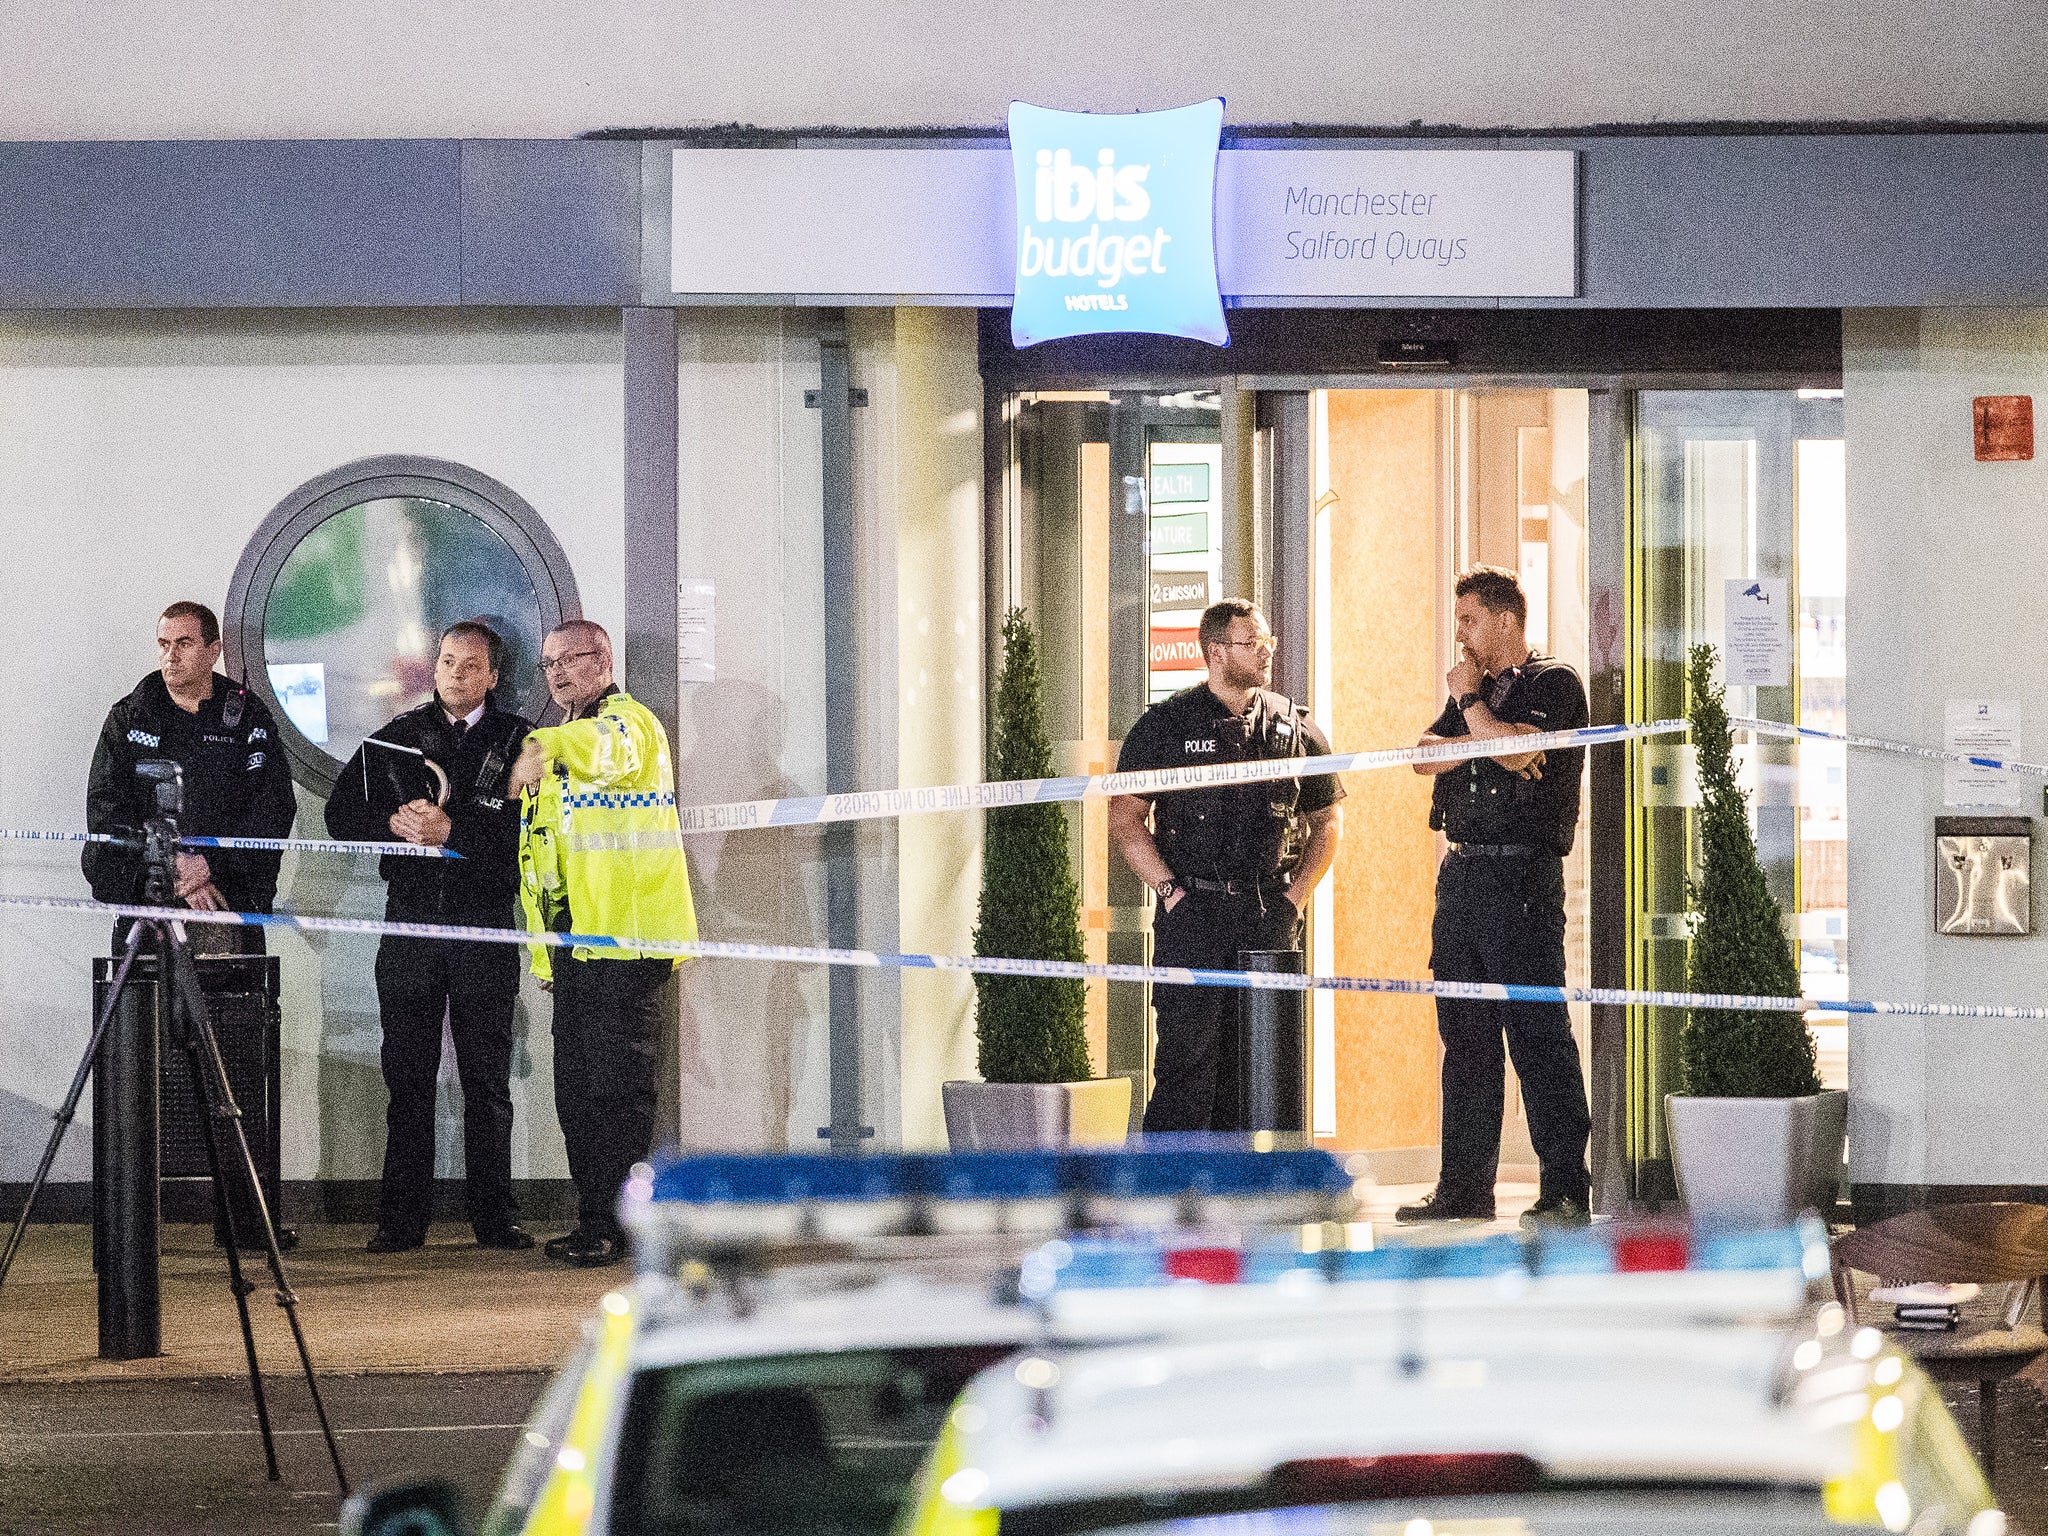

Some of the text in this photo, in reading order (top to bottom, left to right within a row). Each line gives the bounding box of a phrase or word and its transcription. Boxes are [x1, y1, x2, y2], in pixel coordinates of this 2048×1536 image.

[1035, 147, 1152, 223] ibis
[1285, 187, 1438, 216] Manchester
[1020, 226, 1172, 287] budget
[1285, 231, 1468, 266] Salford Quays
[1064, 293, 1129, 312] HOTELS
[1162, 582, 1205, 602] EMISSION
[1184, 739, 1217, 753] POLICE
